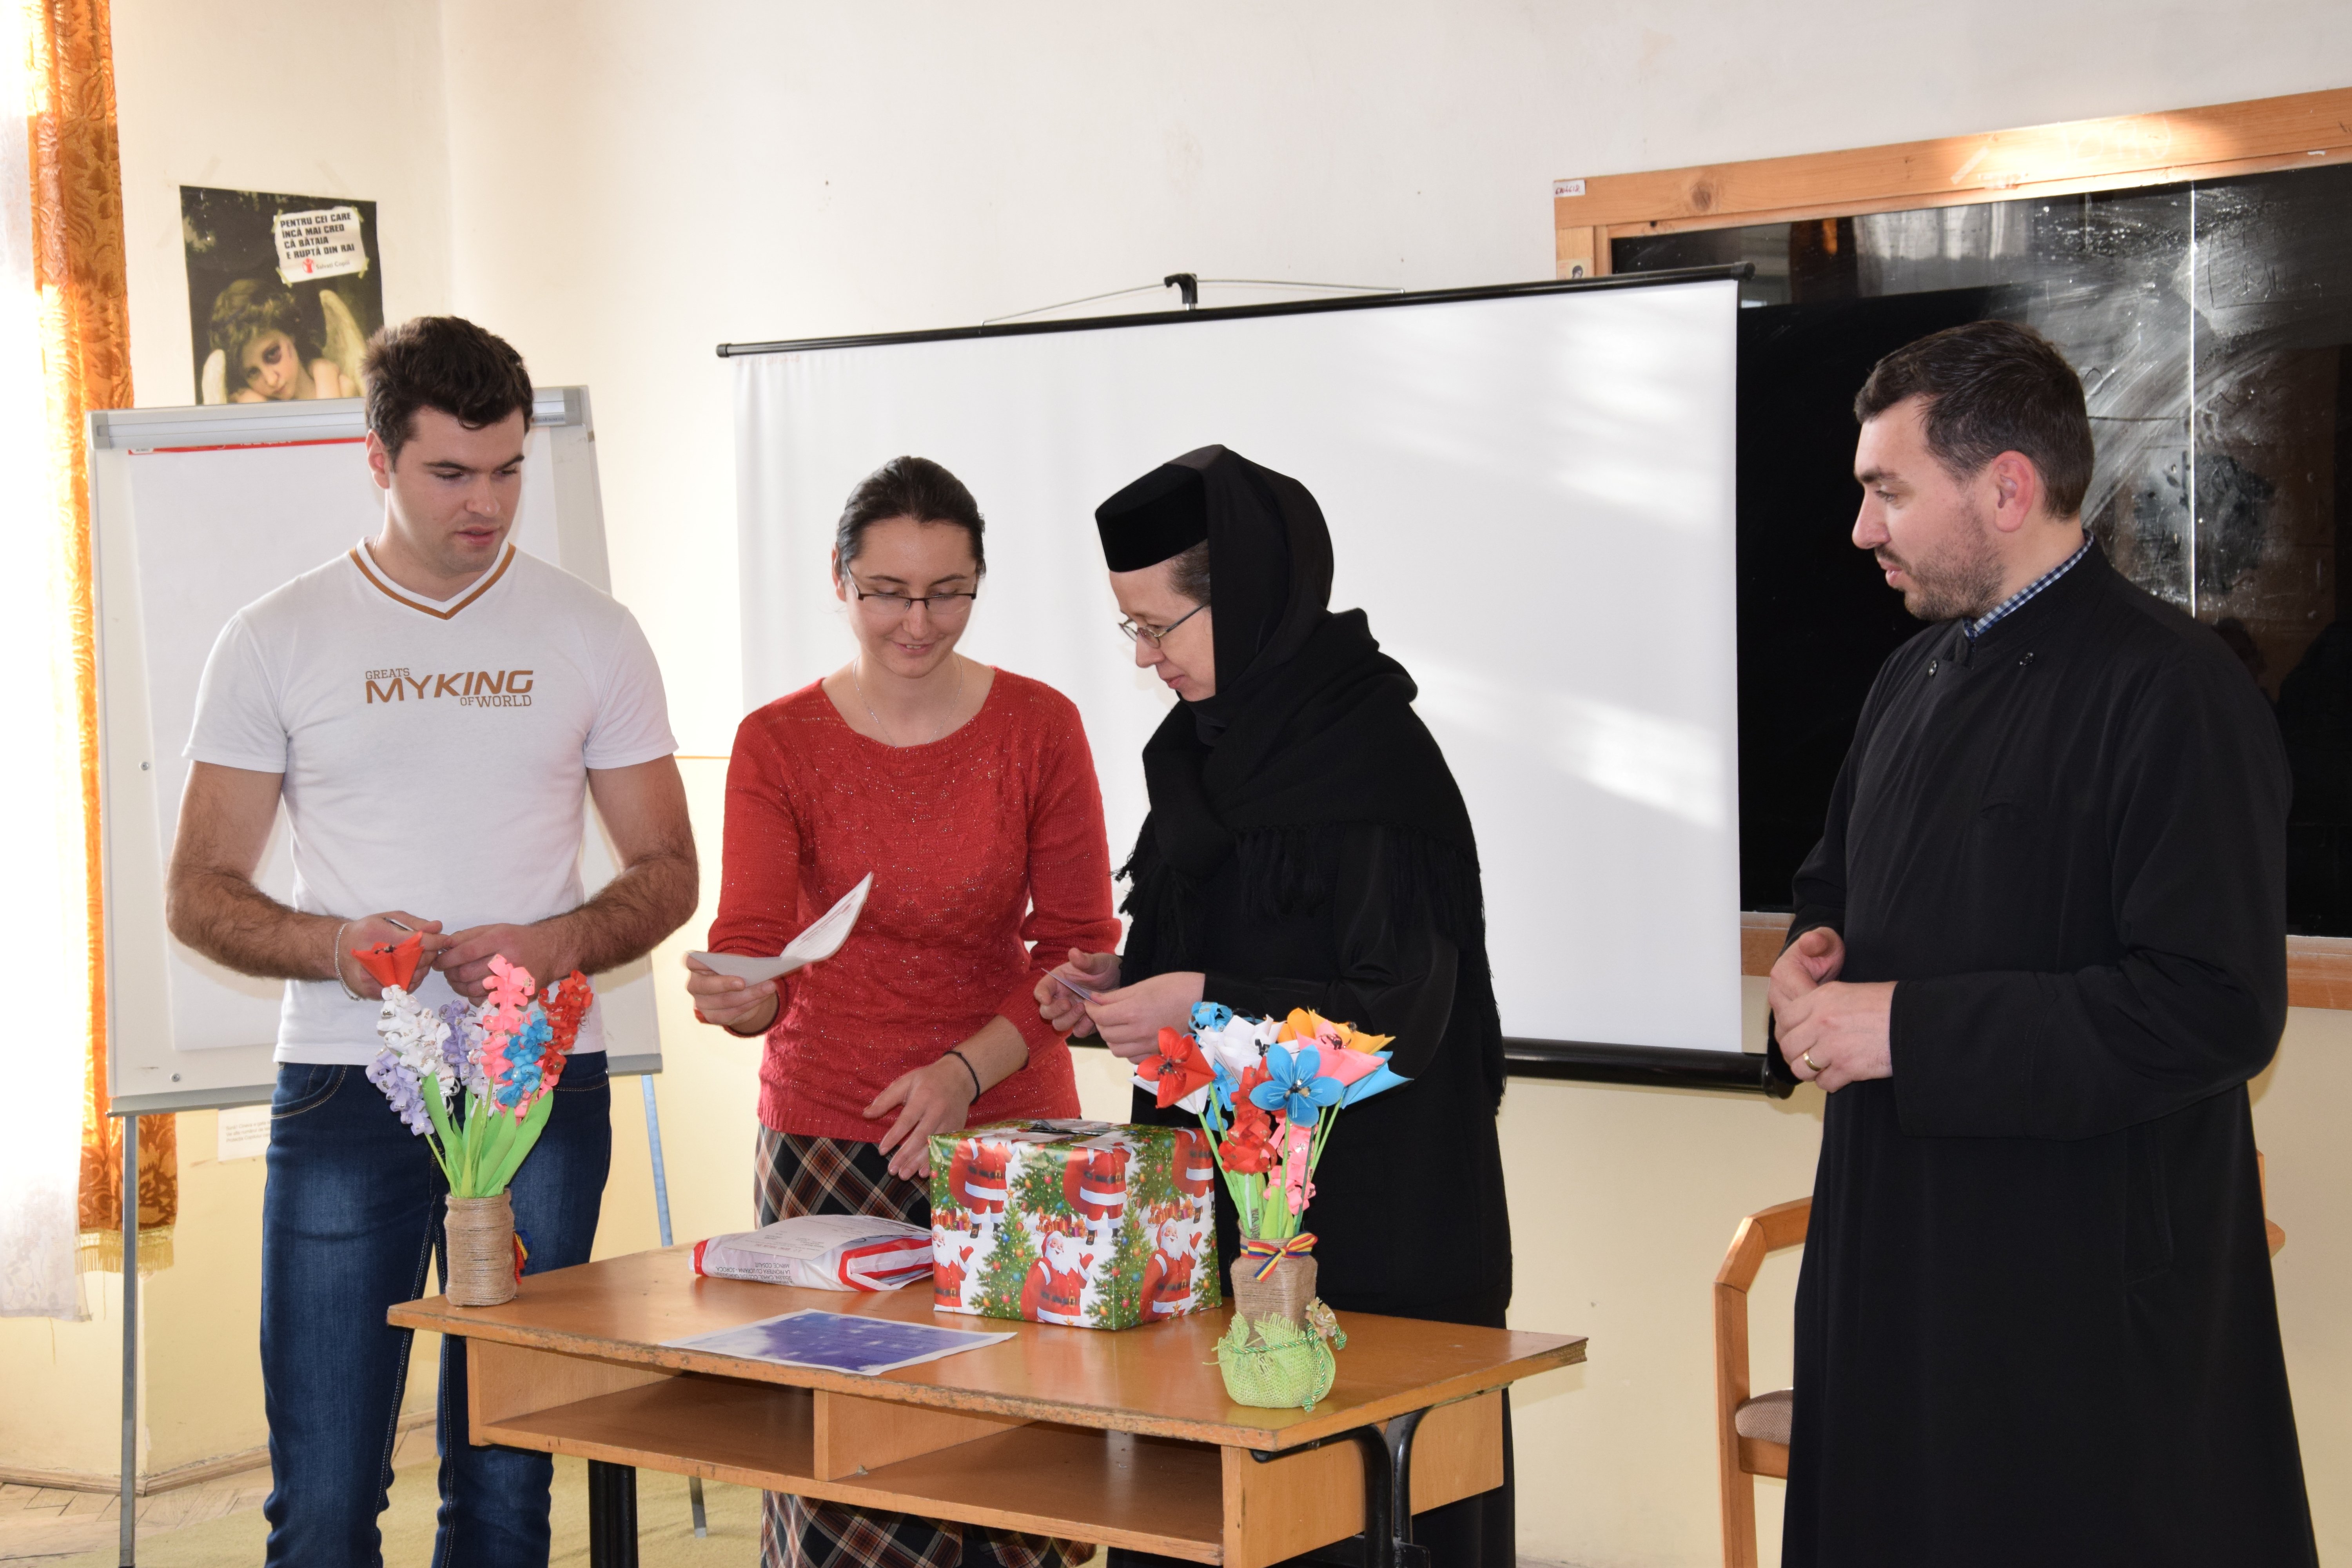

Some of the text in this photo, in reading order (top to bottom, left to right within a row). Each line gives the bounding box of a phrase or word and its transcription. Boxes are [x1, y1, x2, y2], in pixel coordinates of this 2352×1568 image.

[280, 212, 351, 228] PENTRU CEI CARE
[305, 227, 321, 235] MAI
[324, 224, 345, 233] CRED
[284, 236, 328, 249] CĂ BĂTAIA
[294, 246, 321, 258] RUPTĂ
[323, 246, 338, 254] DIN
[341, 243, 355, 252] RAI
[365, 668, 410, 680] GREATS
[460, 695, 532, 707] OF WORLD
